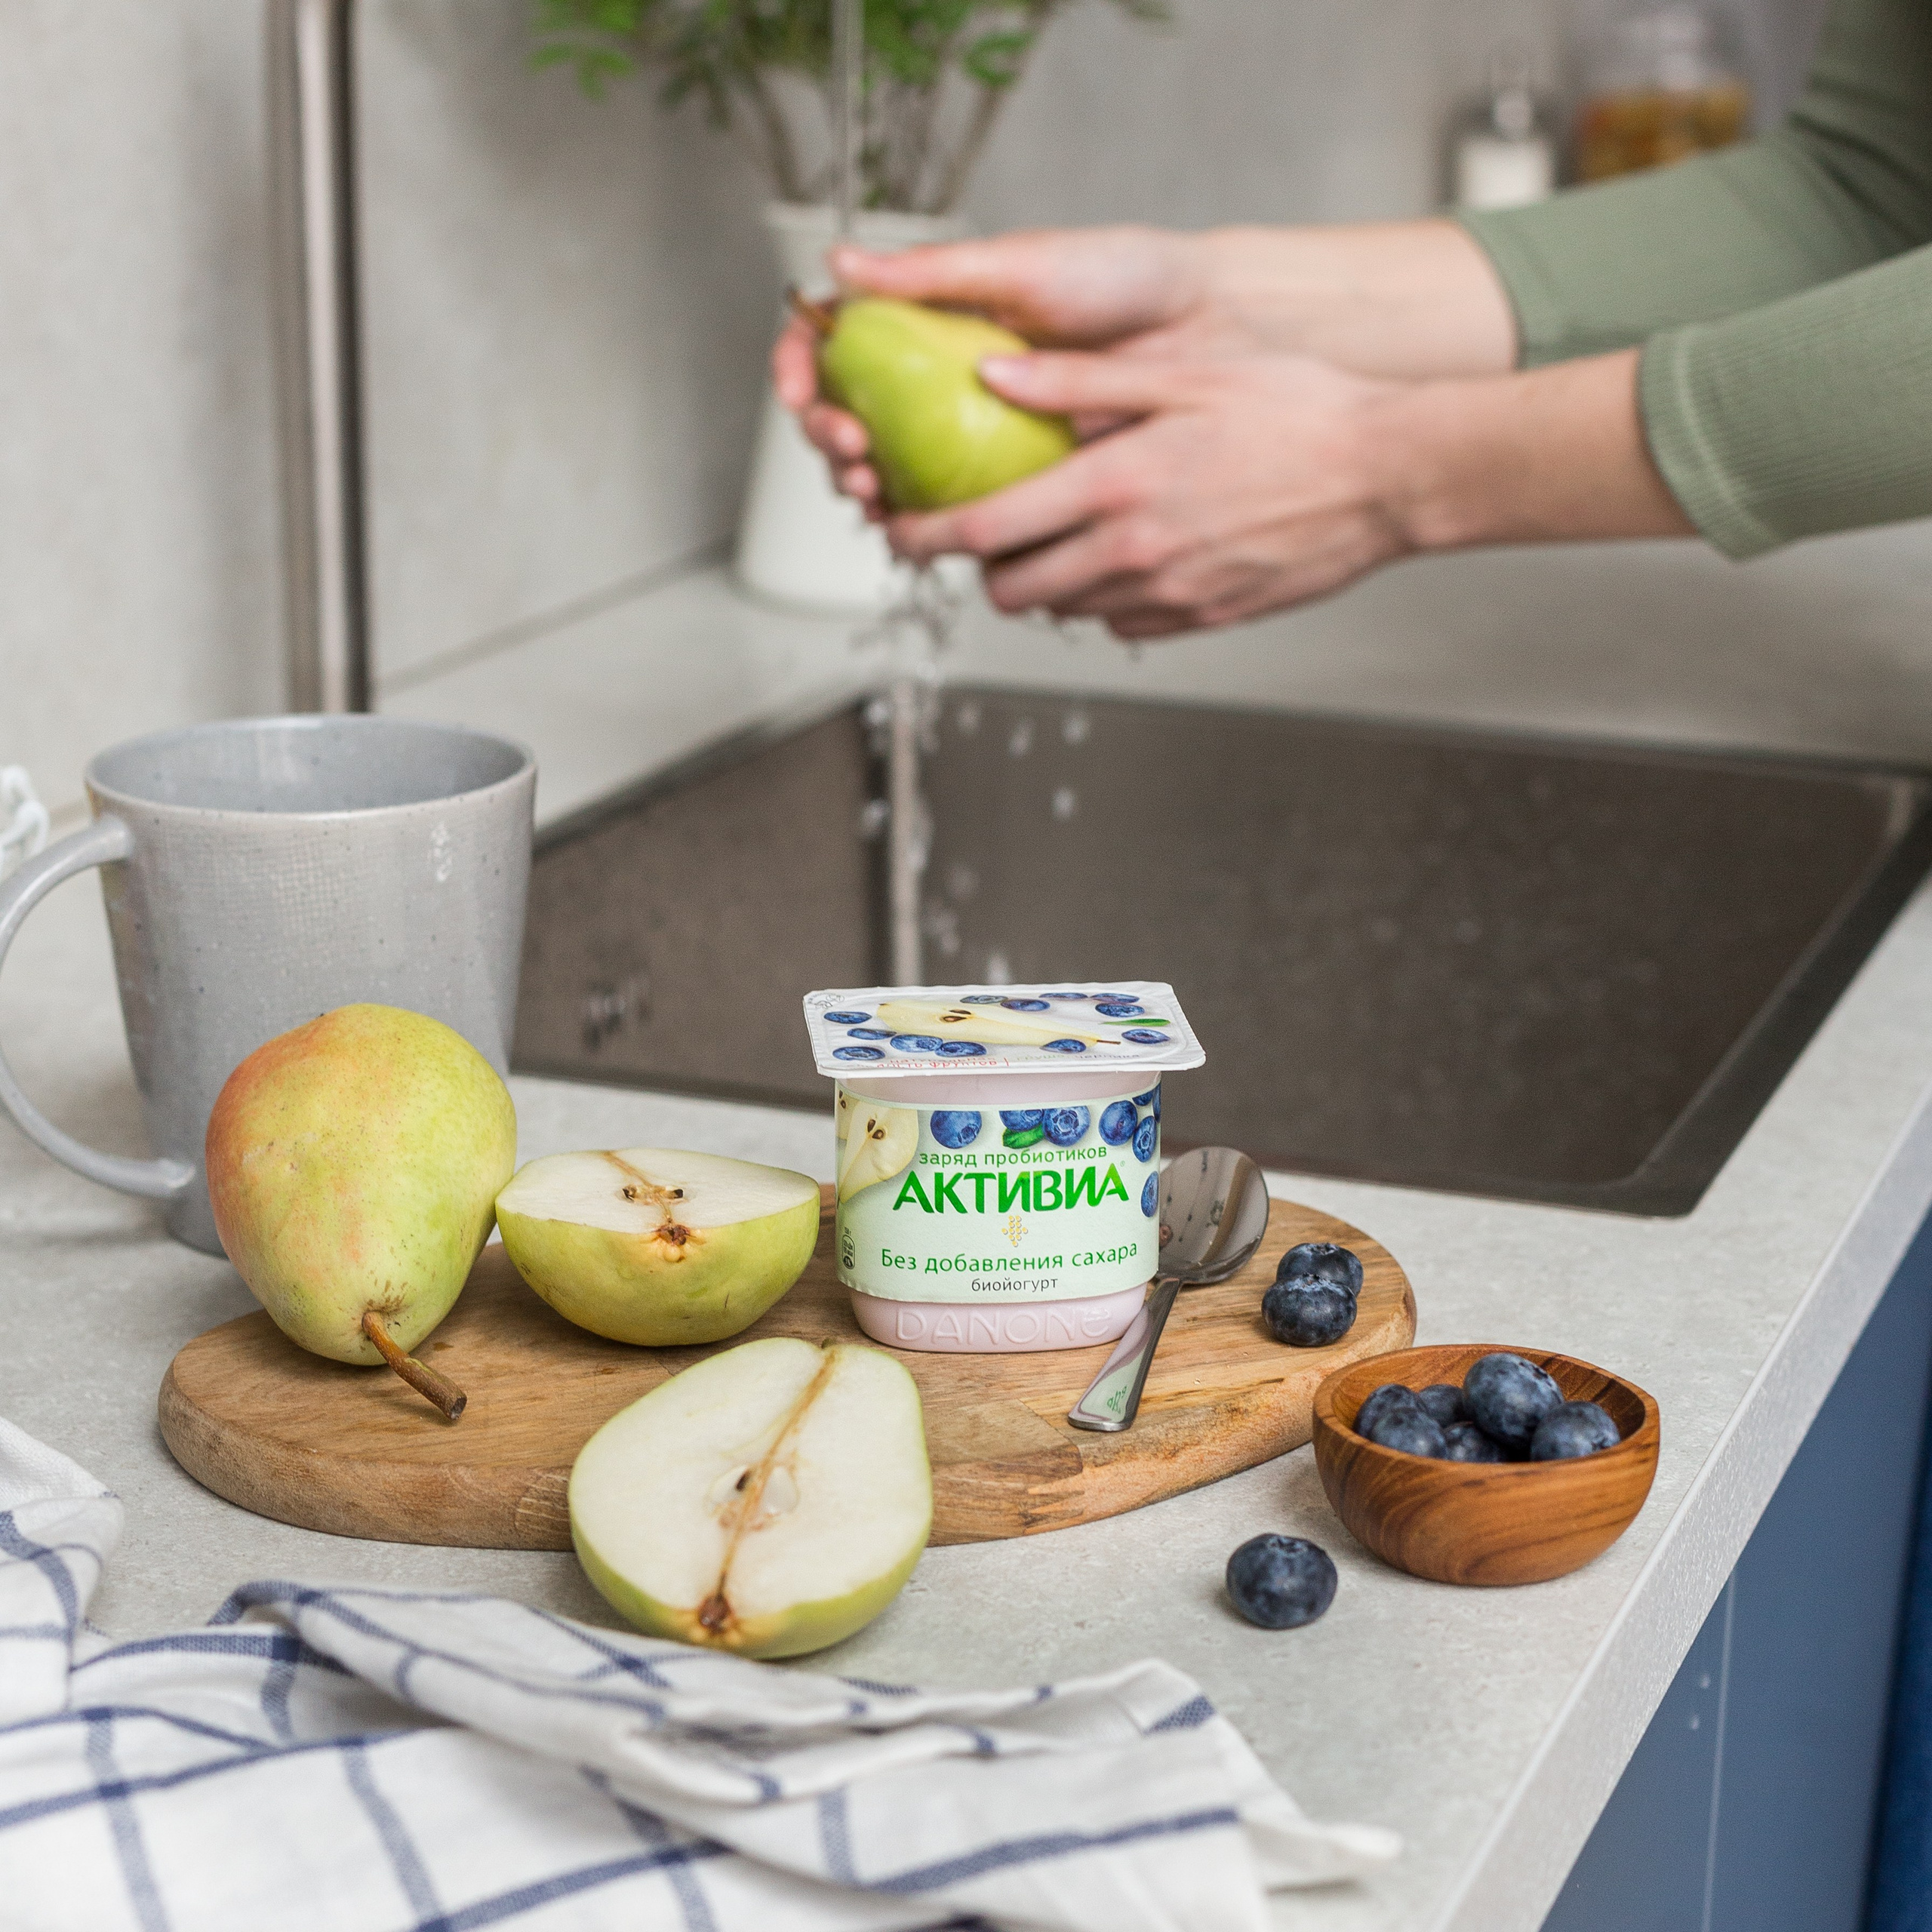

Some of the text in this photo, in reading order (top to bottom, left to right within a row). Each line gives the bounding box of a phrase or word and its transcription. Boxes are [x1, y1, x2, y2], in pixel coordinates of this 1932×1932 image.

[918, 1146, 1107, 1168] заряд пробиотиков
[892, 1163, 1130, 1214] АКТИВИА
[881, 1243, 1137, 1275] Без добавления сахара
[971, 1276, 1058, 1293] биойогурт
